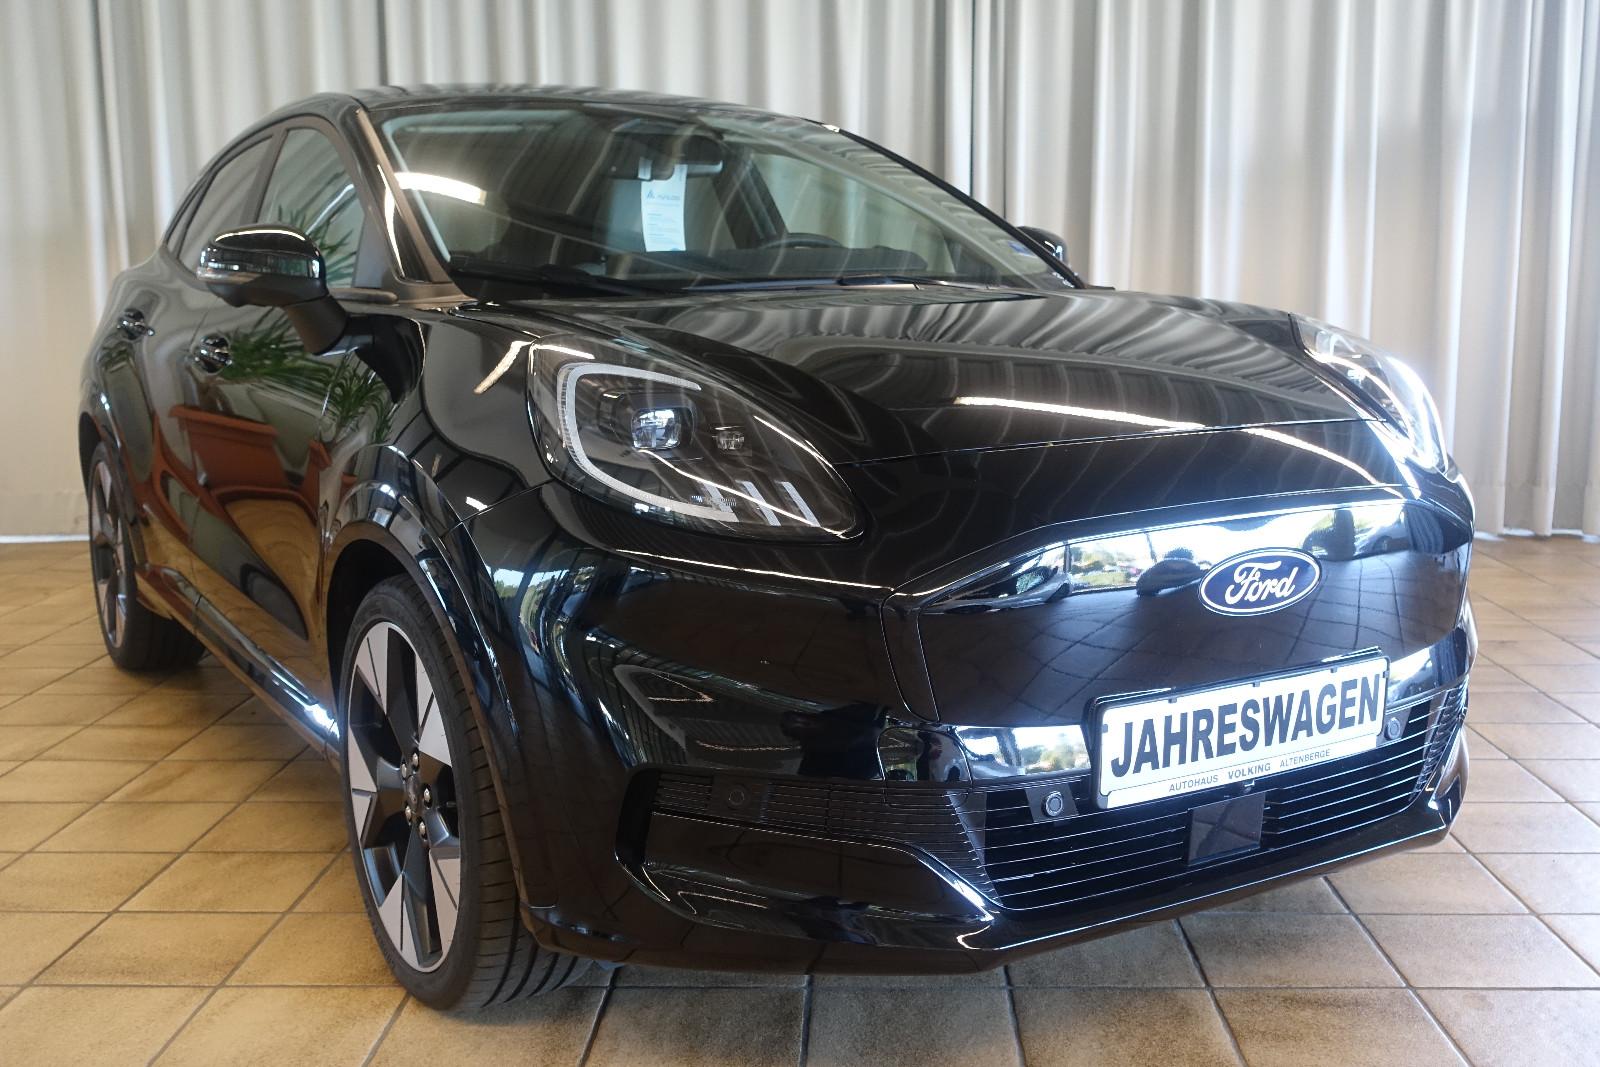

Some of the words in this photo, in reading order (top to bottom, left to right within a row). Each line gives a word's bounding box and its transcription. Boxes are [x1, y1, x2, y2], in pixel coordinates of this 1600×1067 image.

[1225, 560, 1299, 605] Ford
[1111, 673, 1381, 778] JAHRESWAGEN
[1168, 774, 1219, 793] AUTOHAUS
[1279, 748, 1331, 769] ALTENBERGE
